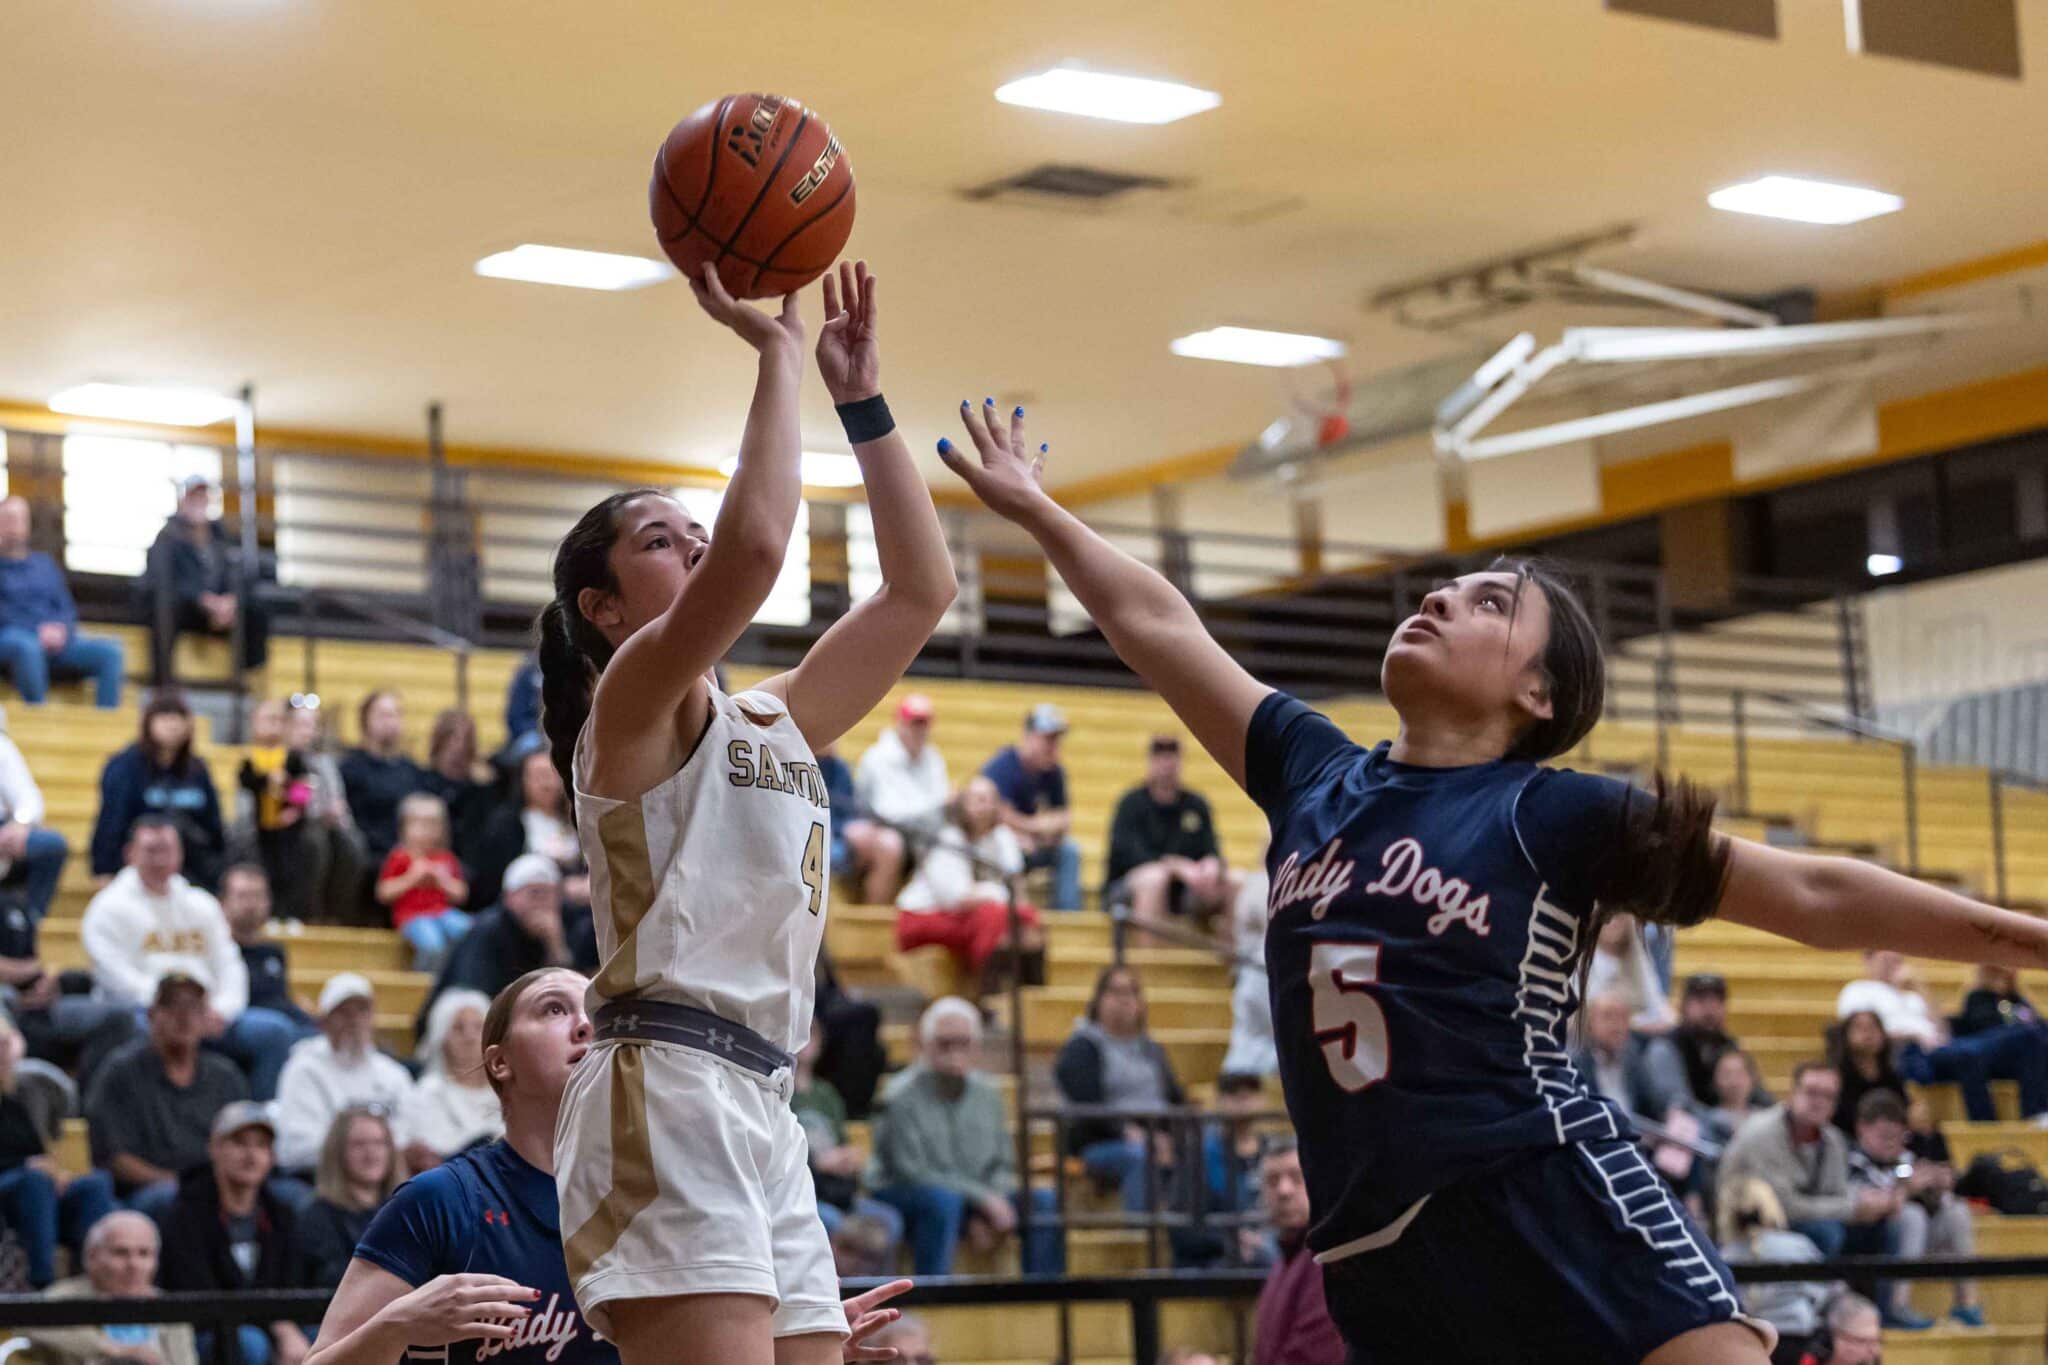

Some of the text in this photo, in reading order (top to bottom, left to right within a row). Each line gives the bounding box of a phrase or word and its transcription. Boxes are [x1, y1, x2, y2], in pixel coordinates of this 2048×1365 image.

[788, 132, 845, 206] ELITE
[800, 820, 825, 917] 4
[1268, 837, 1491, 937] Lady Dogs
[1308, 939, 1392, 1094] 5
